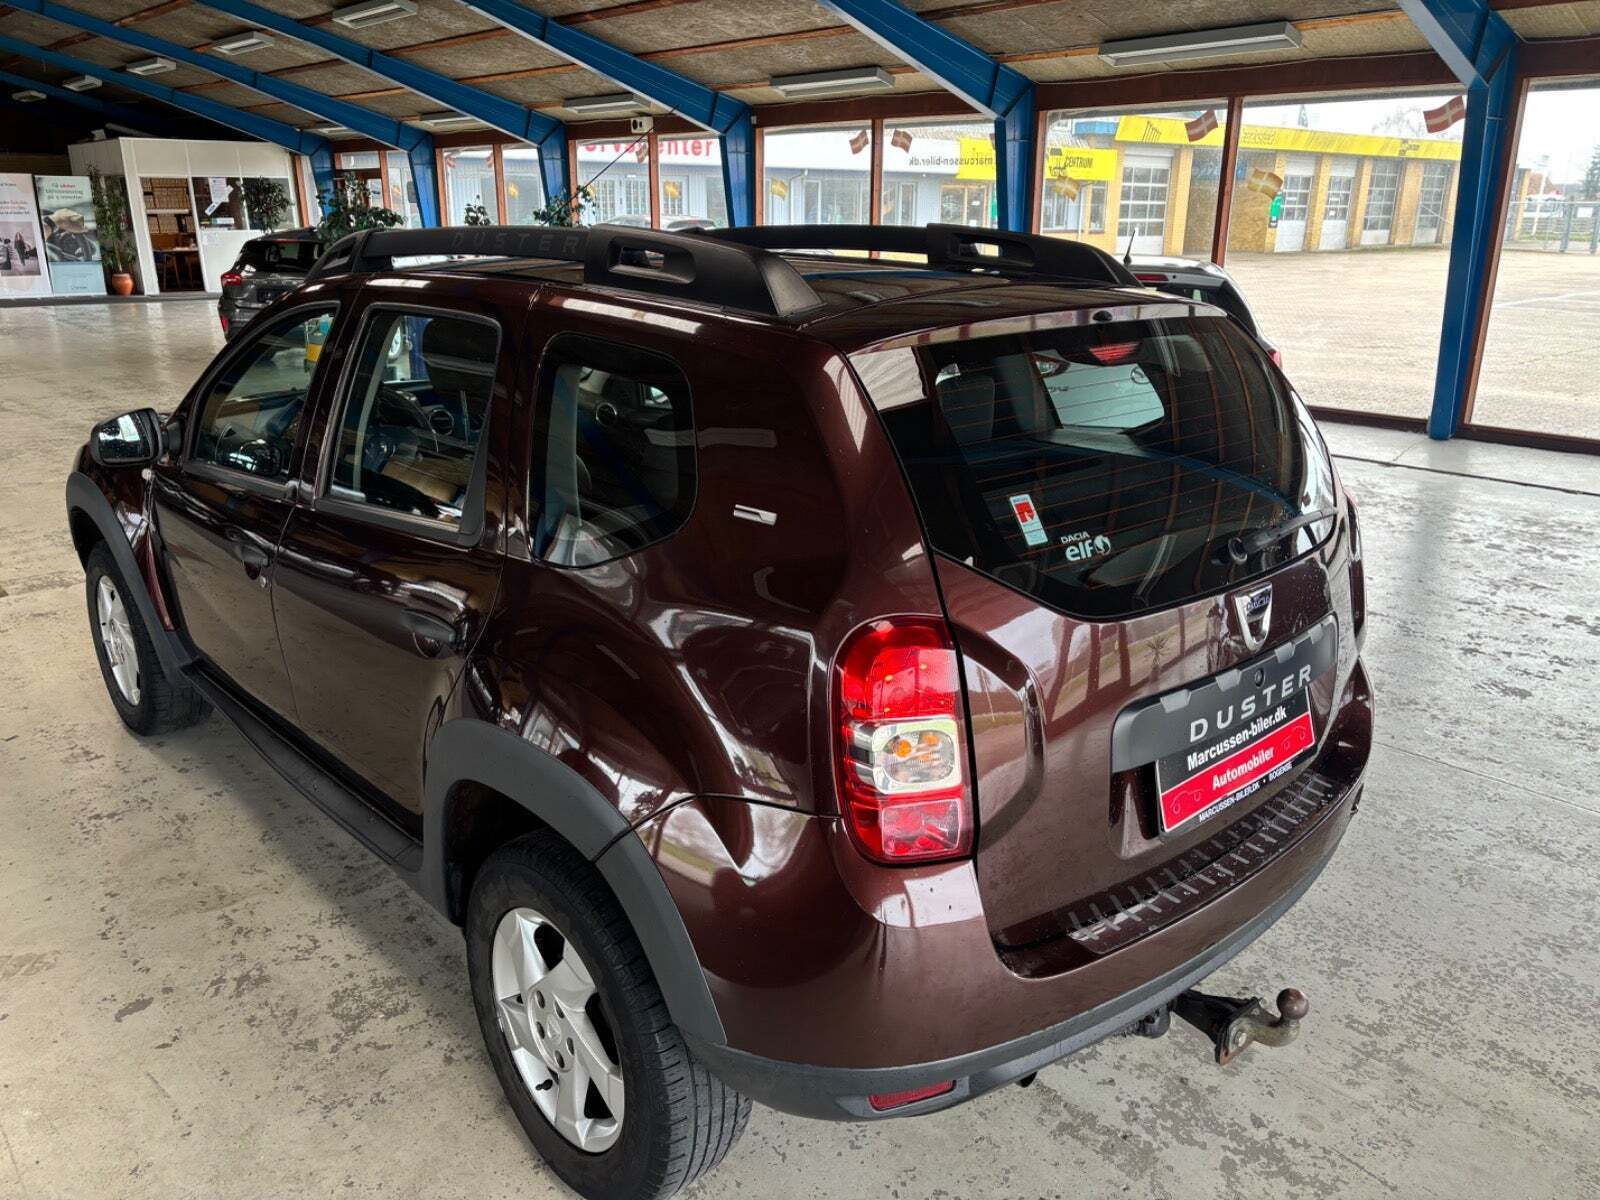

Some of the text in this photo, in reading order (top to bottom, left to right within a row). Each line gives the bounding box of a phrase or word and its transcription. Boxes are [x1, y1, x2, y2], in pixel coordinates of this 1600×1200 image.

[450, 231, 580, 254] DUSTER
[1061, 531, 1090, 544] DACIA
[1065, 540, 1094, 562] elf
[1190, 664, 1312, 743] DUSTER
[1187, 705, 1287, 771] Marcussen-biler.dk
[1212, 747, 1274, 791] Automobiler
[1199, 782, 1260, 823] MARCUSSEN-BILER.DK
